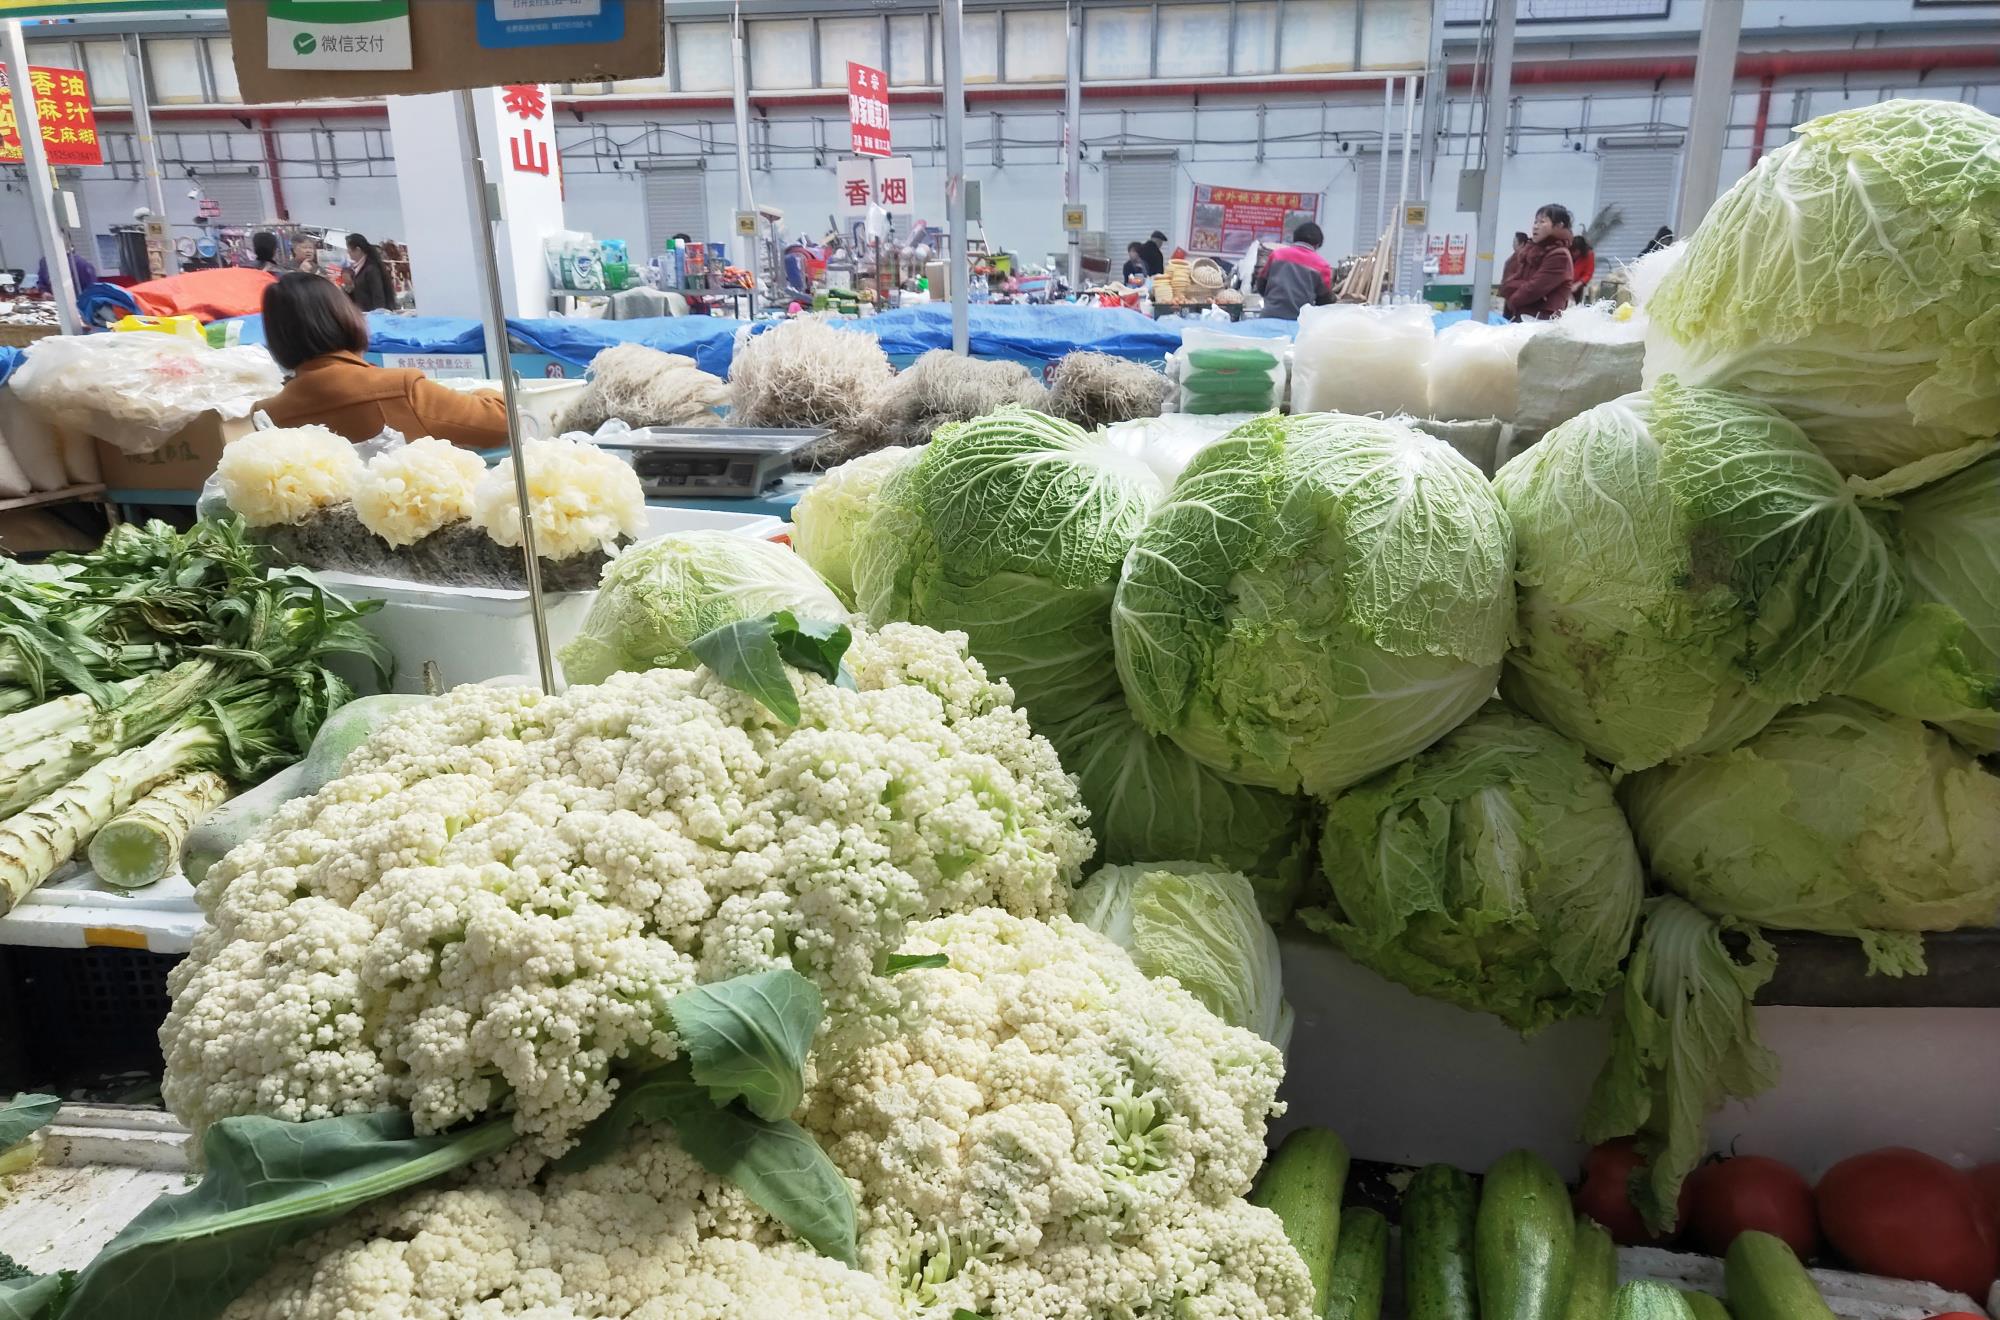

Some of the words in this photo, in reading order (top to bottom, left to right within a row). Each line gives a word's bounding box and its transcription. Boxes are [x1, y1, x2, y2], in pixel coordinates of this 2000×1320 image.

[321, 34, 385, 53] 微信支付
[30, 71, 86, 97] 香油
[36, 98, 90, 123] 麻汁
[850, 94, 890, 131] 孙家菜刀
[502, 84, 549, 177] 泰山
[845, 177, 907, 206] 香烟
[398, 357, 473, 369] 食品安全信息公示
[547, 365, 562, 379] 28
